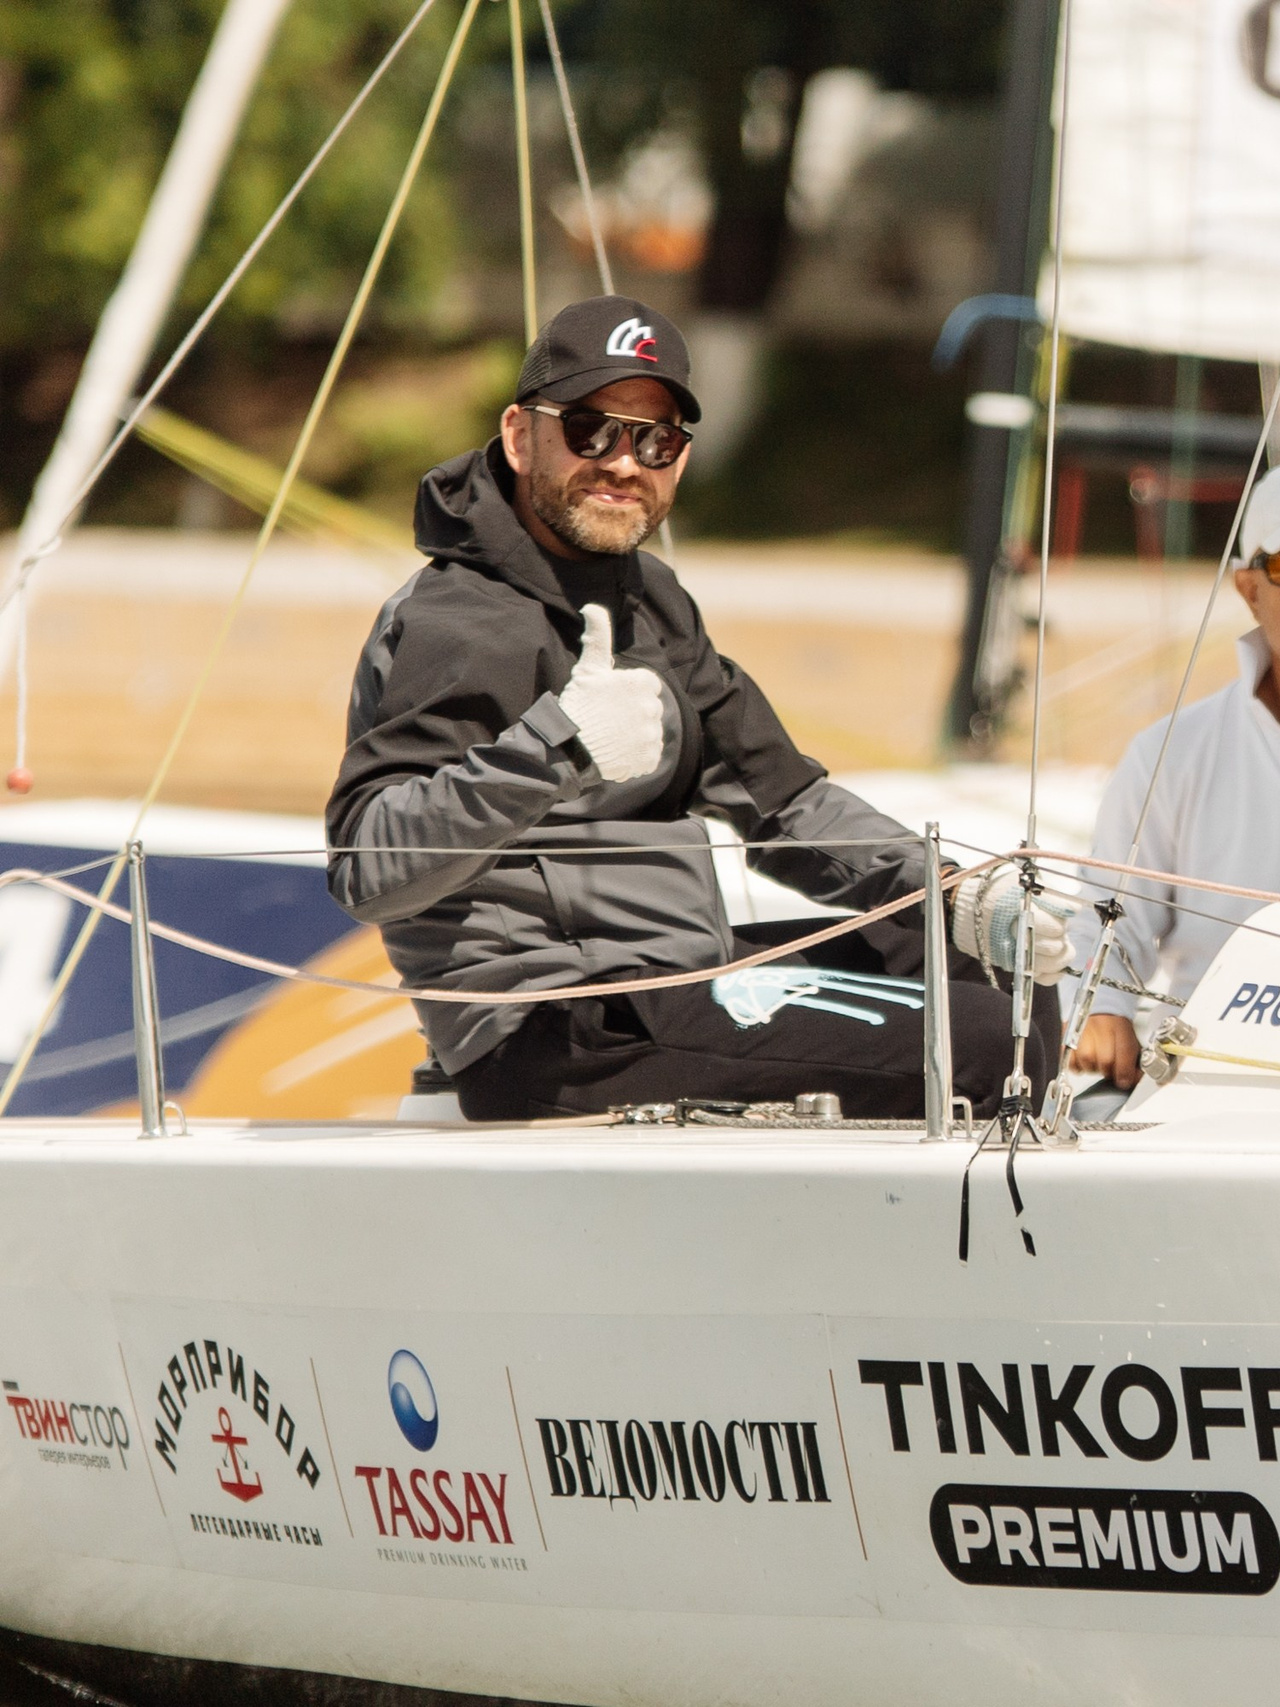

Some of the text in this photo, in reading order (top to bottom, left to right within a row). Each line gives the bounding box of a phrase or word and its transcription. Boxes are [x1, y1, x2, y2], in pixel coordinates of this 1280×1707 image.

[155, 1339, 321, 1490] МОРПРИБОР
[535, 1418, 833, 1512] ВЕДОМОСТИ
[190, 1513, 323, 1547] ЛЕГЕНДАРНЫЕ ЧАСЫ
[355, 1466, 514, 1545] TASSAY
[948, 1503, 1260, 1575] PREMIUM
[377, 1548, 529, 1572] PREMIUM DRINKING WATER
